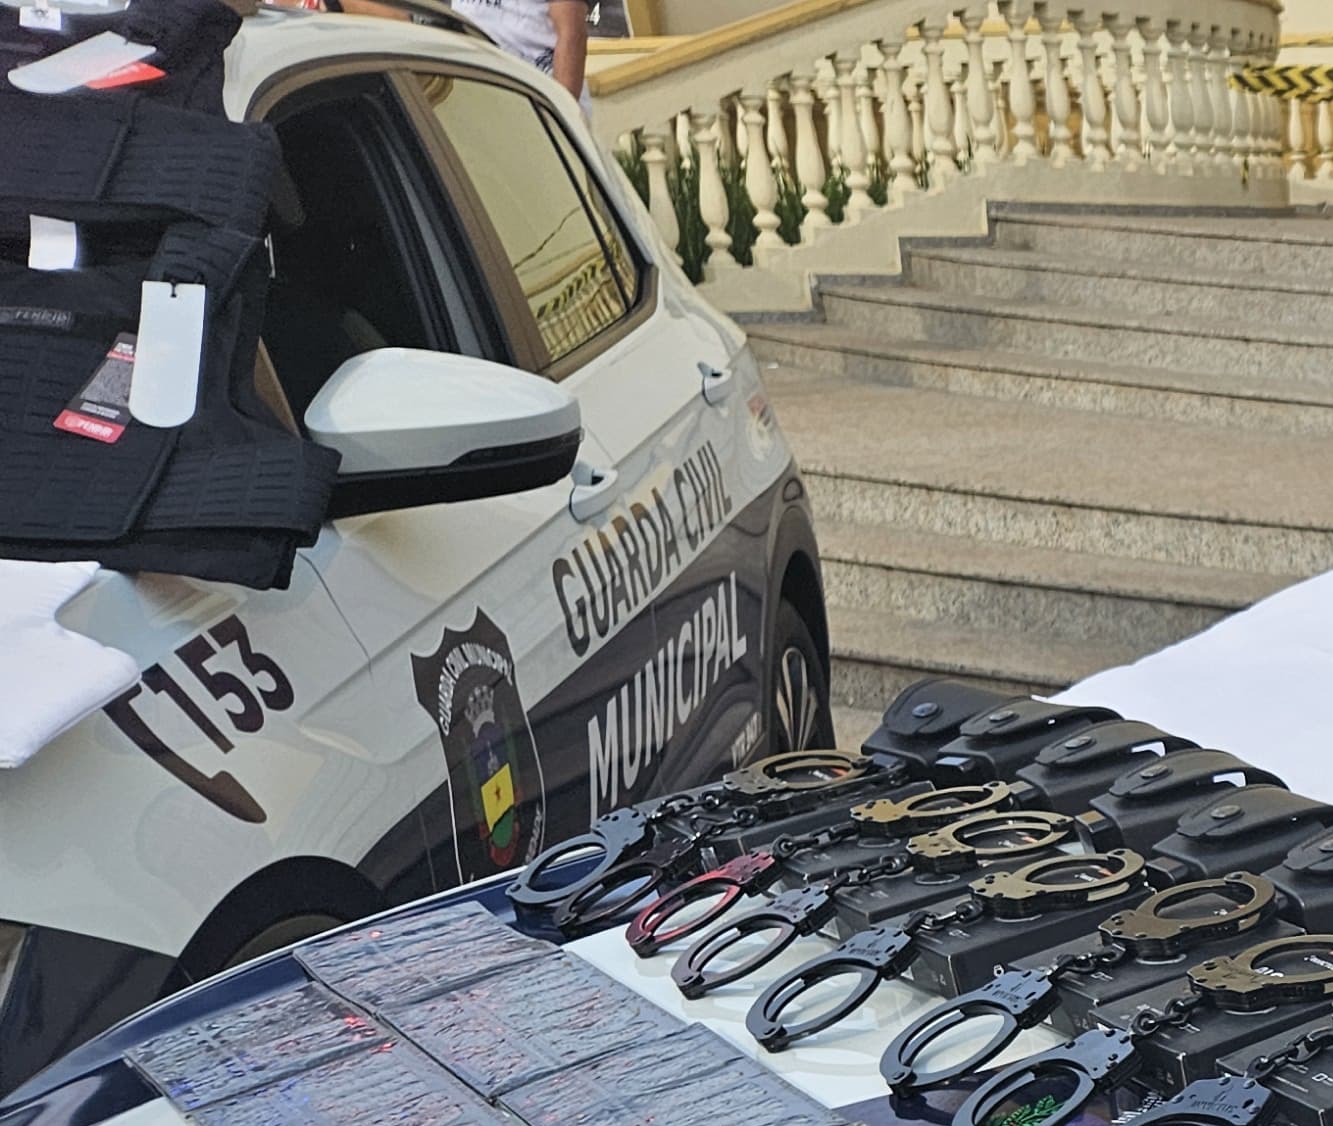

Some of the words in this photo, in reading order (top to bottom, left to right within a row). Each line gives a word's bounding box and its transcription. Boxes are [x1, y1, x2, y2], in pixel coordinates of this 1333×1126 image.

[551, 487, 682, 658] GUARDA
[673, 440, 732, 551] CIVIL
[140, 613, 295, 755] 153
[587, 570, 748, 829] MUNICIPAL
